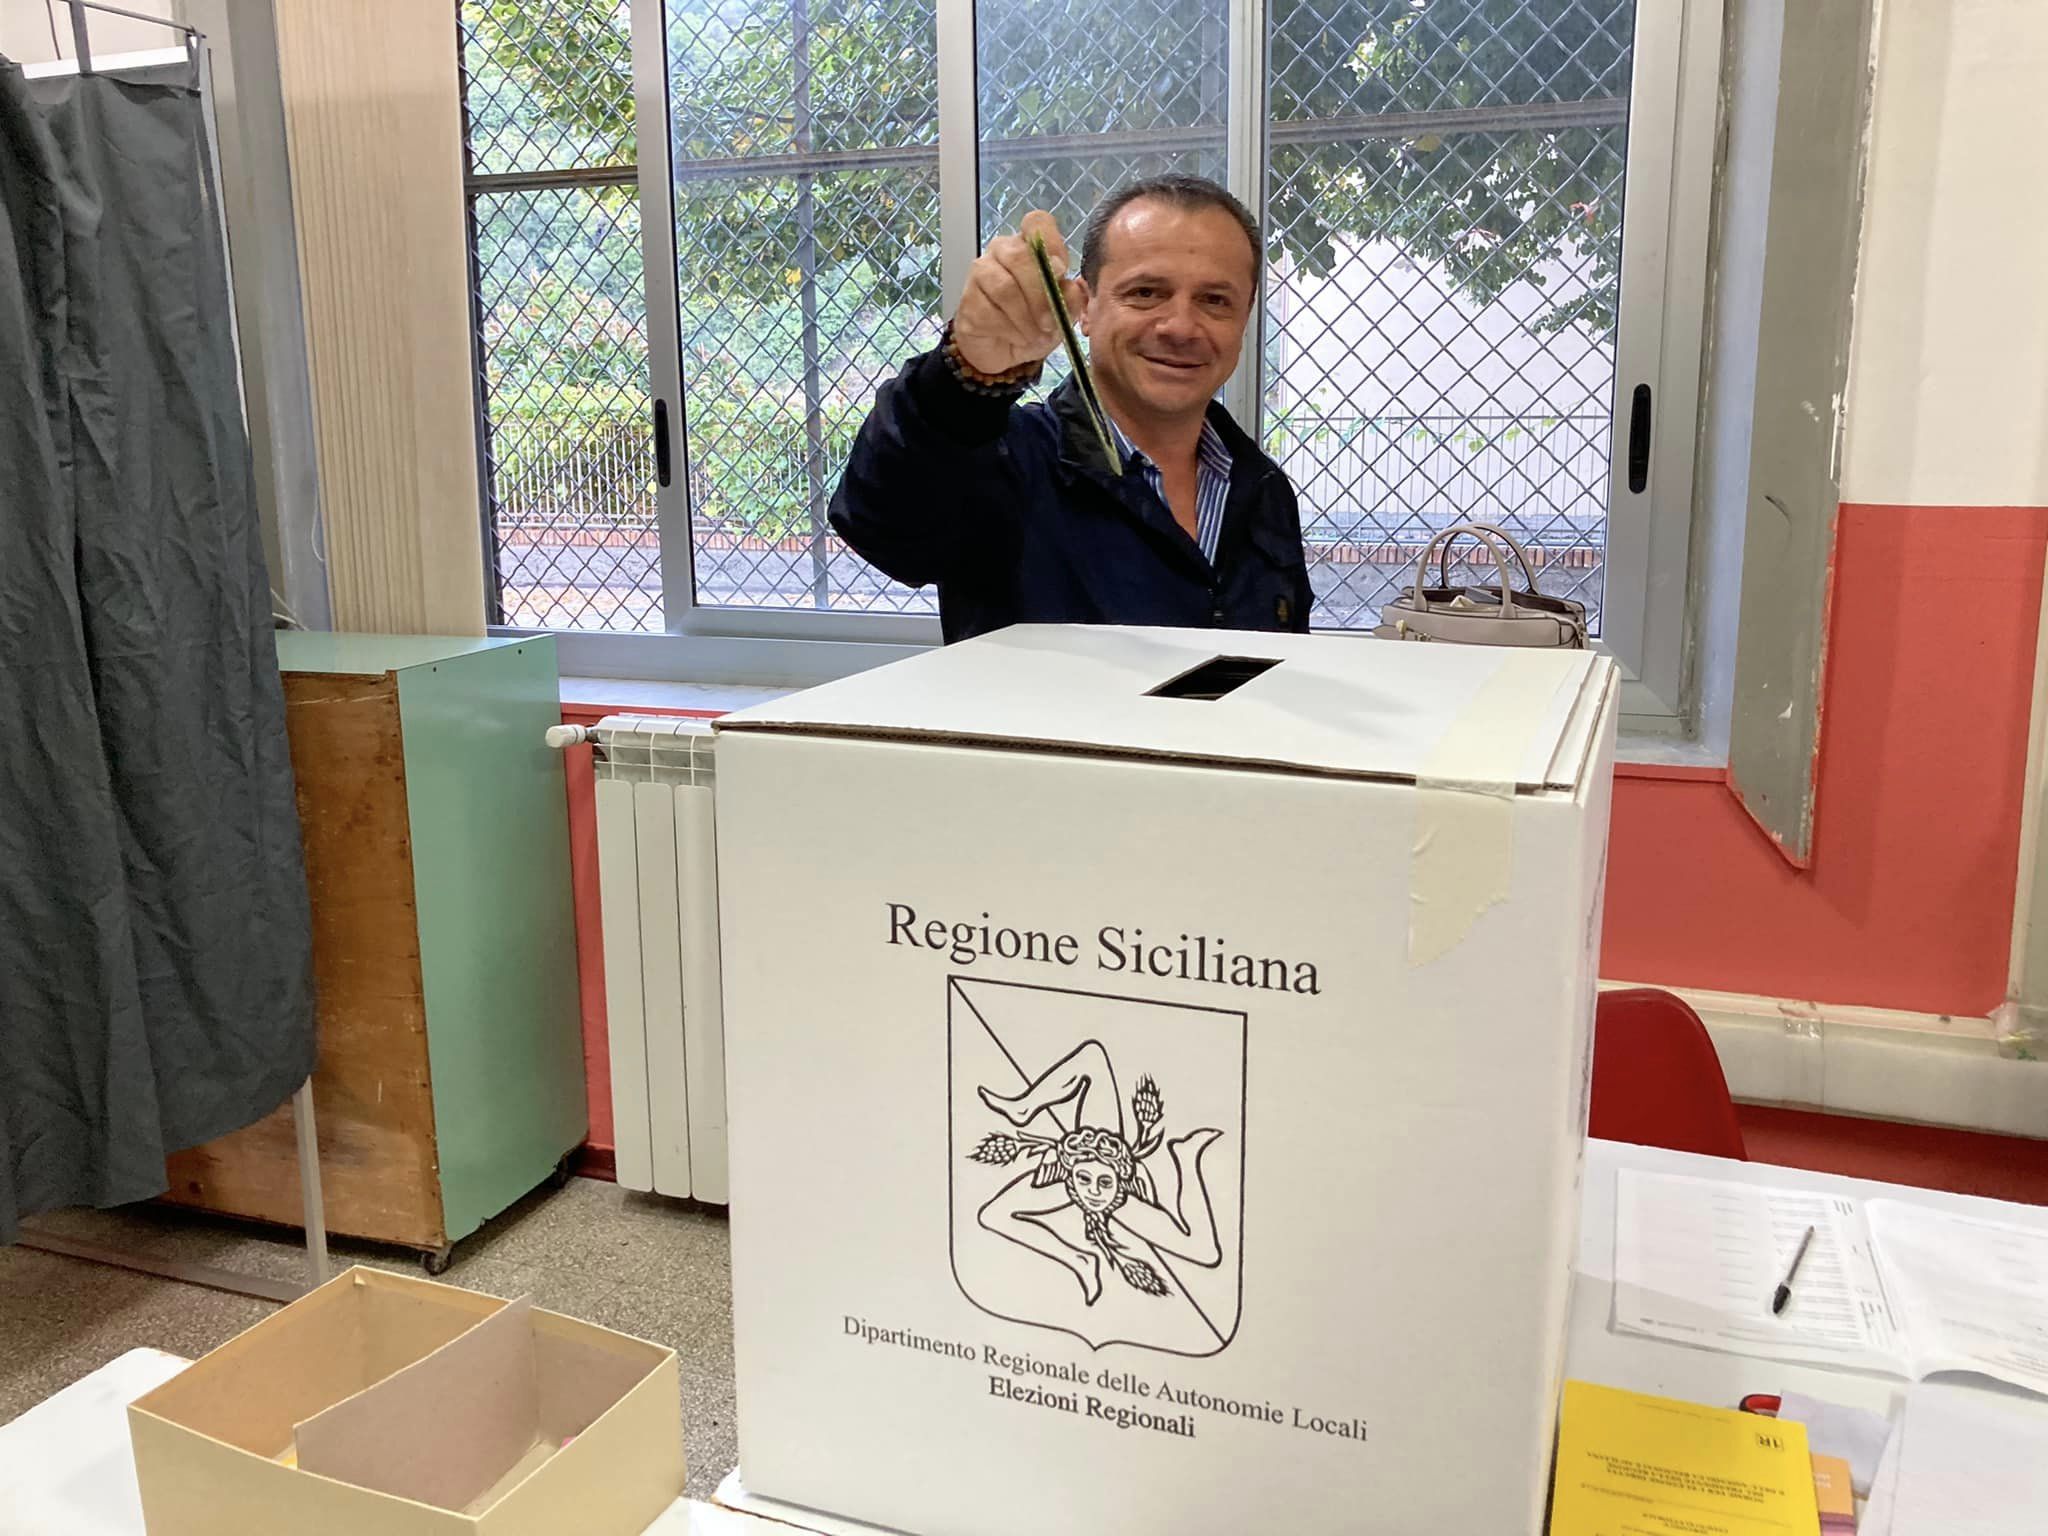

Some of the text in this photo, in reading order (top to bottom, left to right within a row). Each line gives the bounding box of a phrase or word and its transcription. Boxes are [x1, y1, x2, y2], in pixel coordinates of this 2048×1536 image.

[885, 902, 1322, 996] Regione Siciliana
[843, 1315, 1367, 1442] Dipartimento Regionale delle Autonomie Locali
[988, 1375, 1197, 1439] Elezioni Regionali
